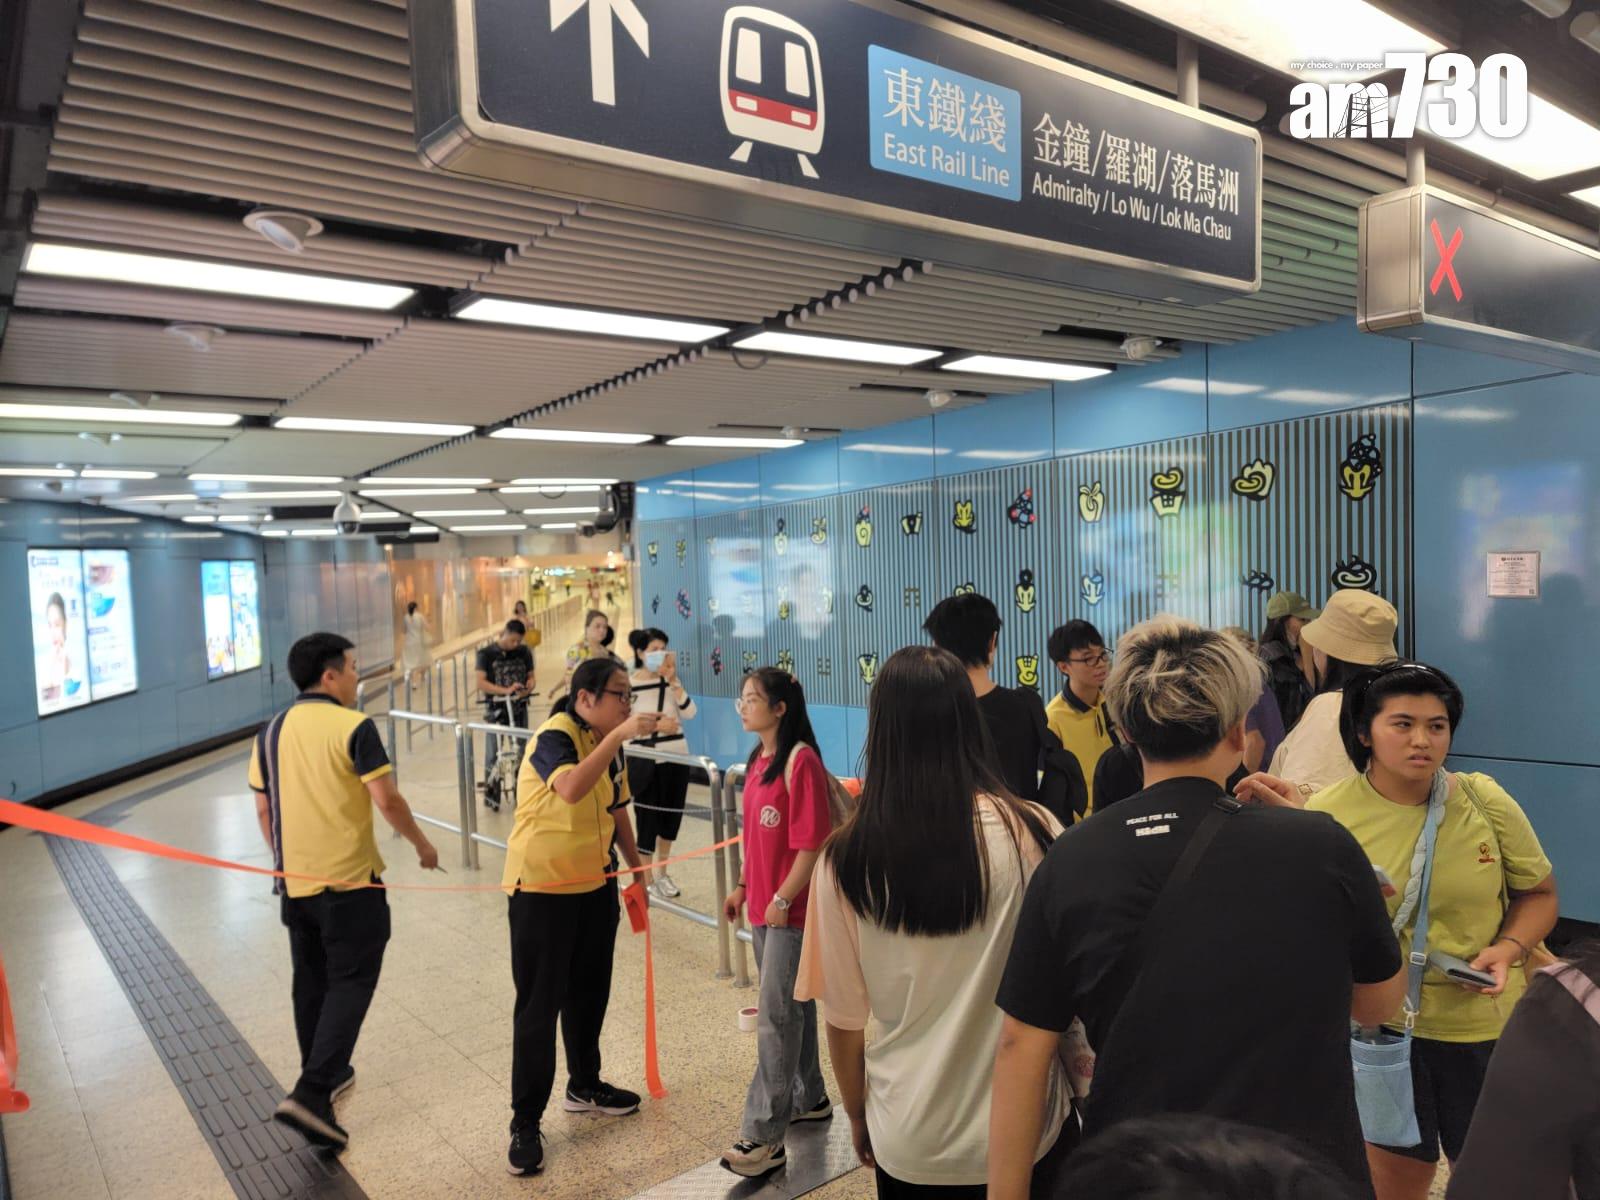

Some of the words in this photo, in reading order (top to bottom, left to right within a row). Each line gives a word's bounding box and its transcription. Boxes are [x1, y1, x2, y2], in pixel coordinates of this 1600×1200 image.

[884, 132, 927, 168] East
[931, 144, 967, 177] Rail
[971, 155, 1010, 187] Line
[1032, 171, 1101, 215] Admiralty
[1111, 191, 1127, 216] Lo
[1129, 195, 1151, 222] Wu
[1160, 204, 1182, 229] Lok
[1183, 210, 1202, 234] Ma
[1203, 215, 1232, 241] Chau
